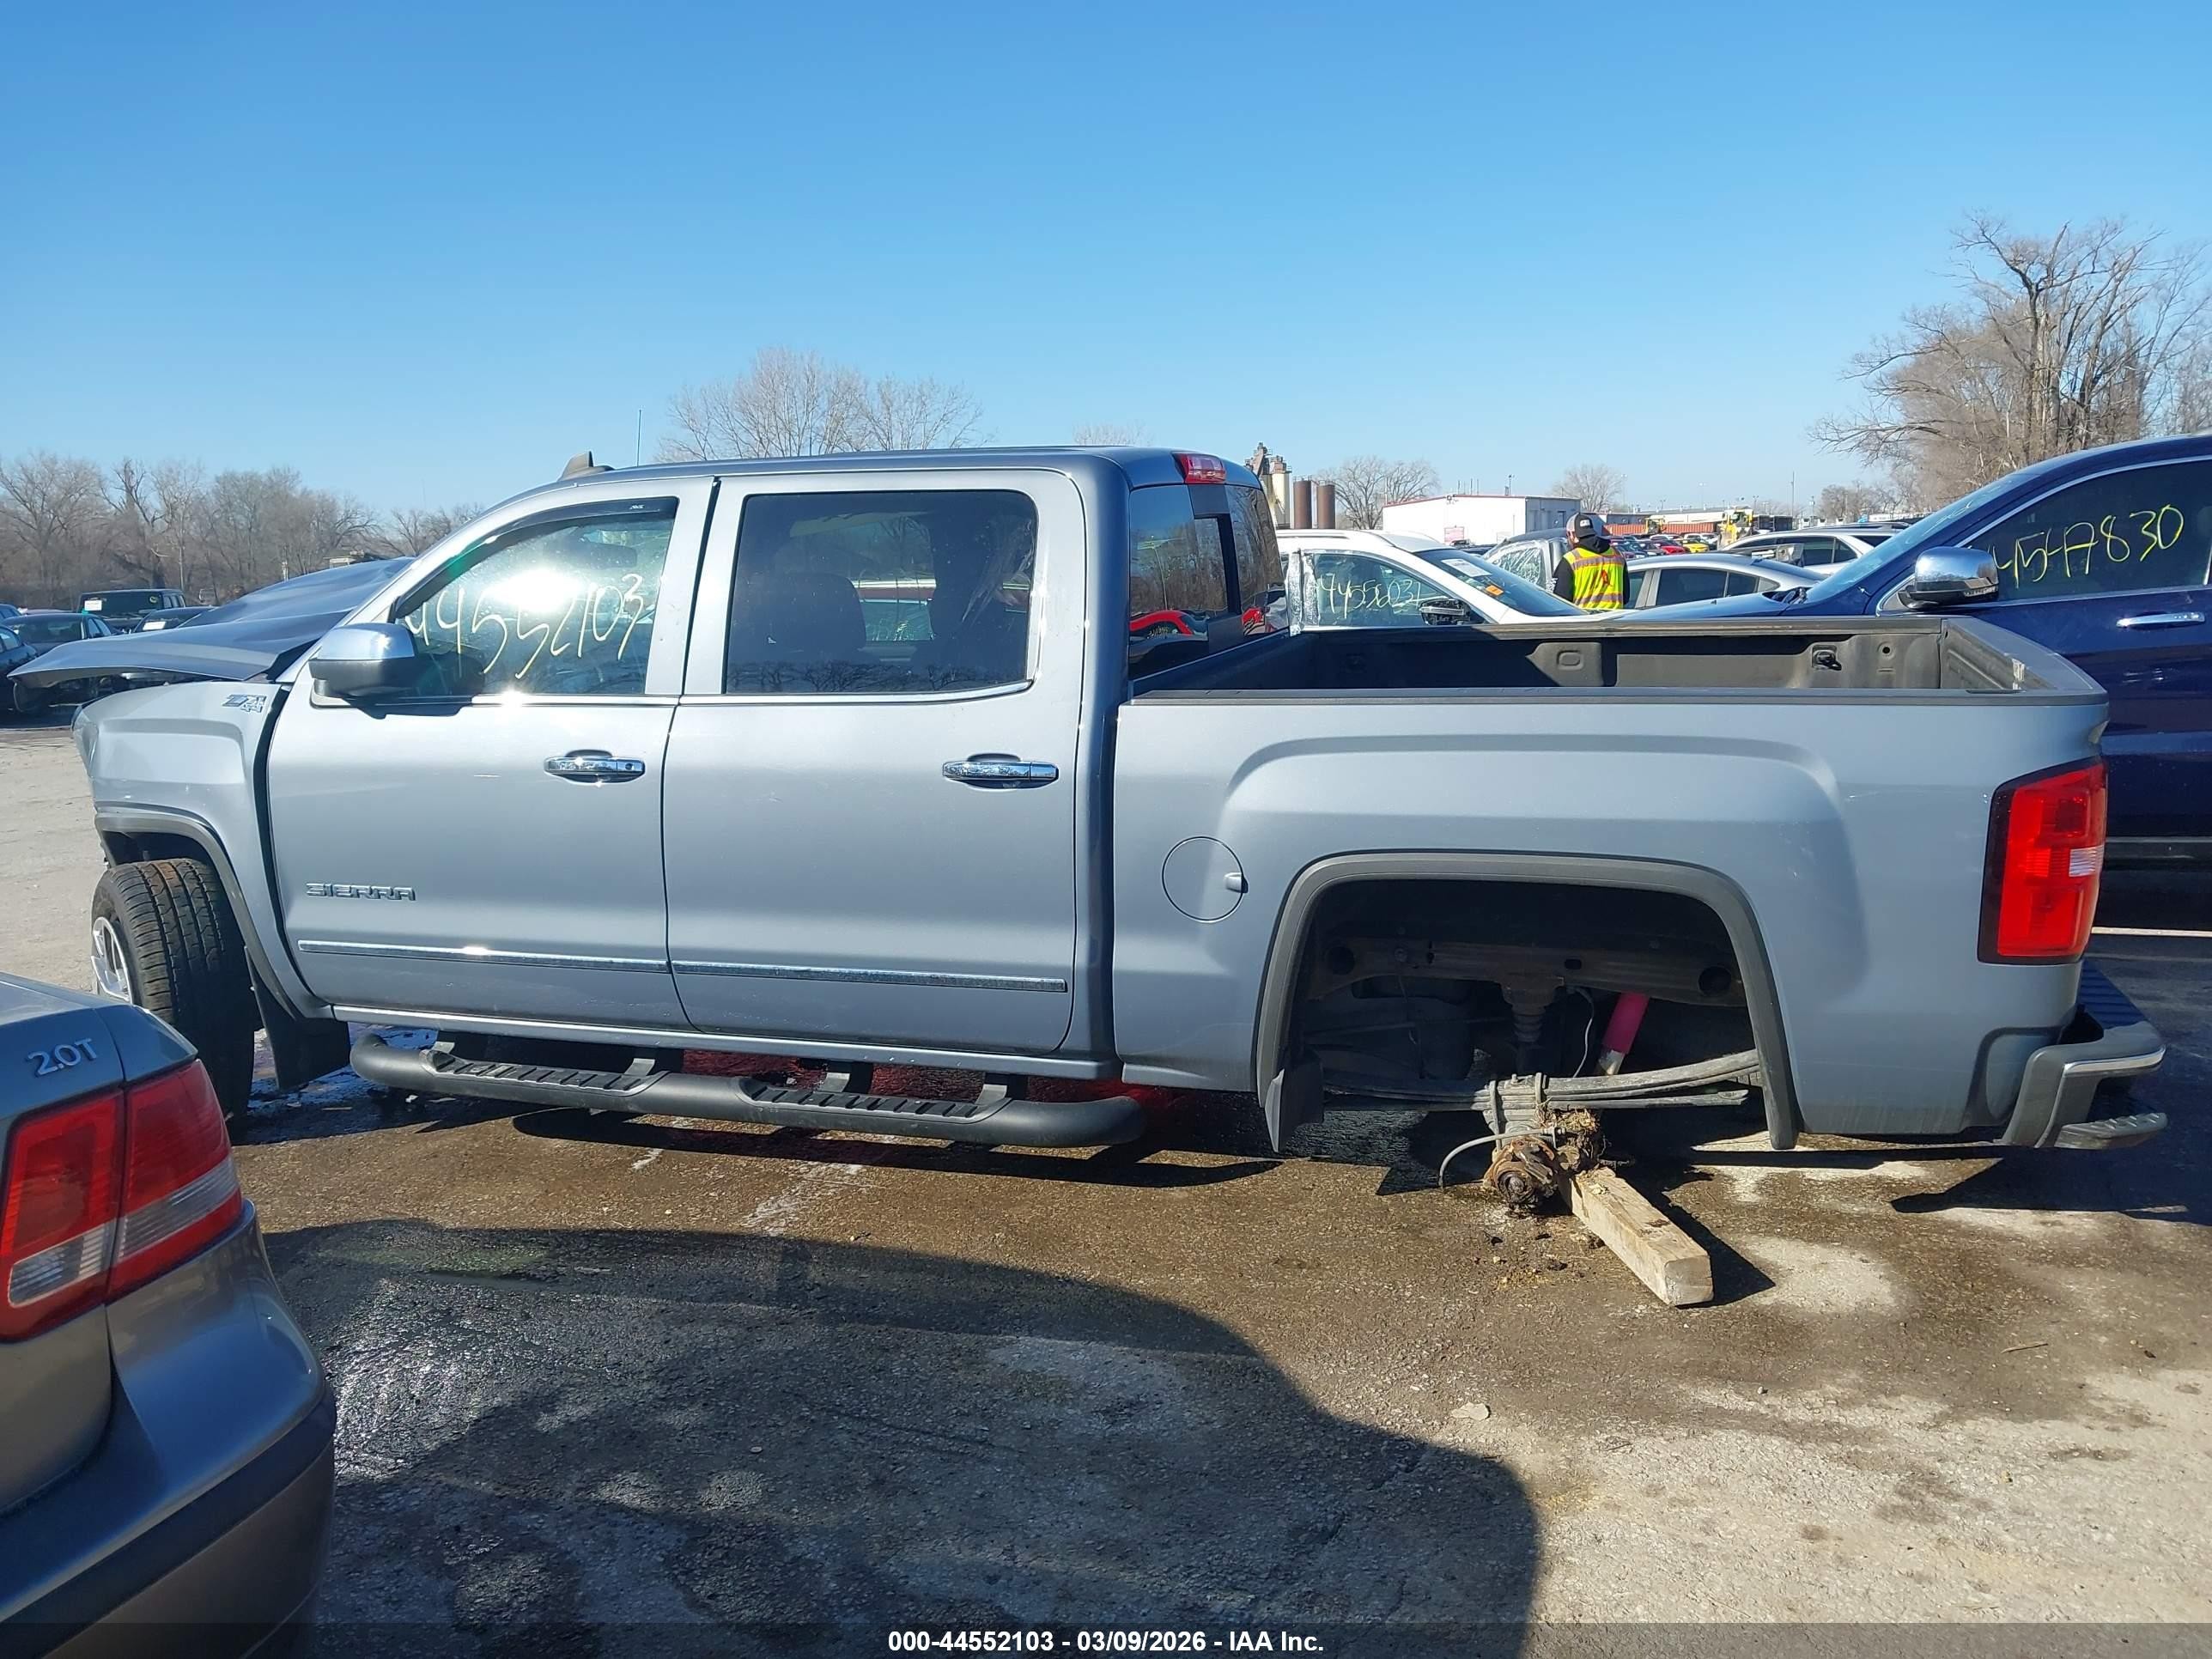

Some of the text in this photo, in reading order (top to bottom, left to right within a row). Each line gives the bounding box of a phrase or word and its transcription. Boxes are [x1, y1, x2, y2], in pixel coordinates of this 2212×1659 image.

[404, 573, 644, 679] 44552103
[306, 883, 416, 901] SIERRA
[27, 1038, 97, 1075] 2.0T
